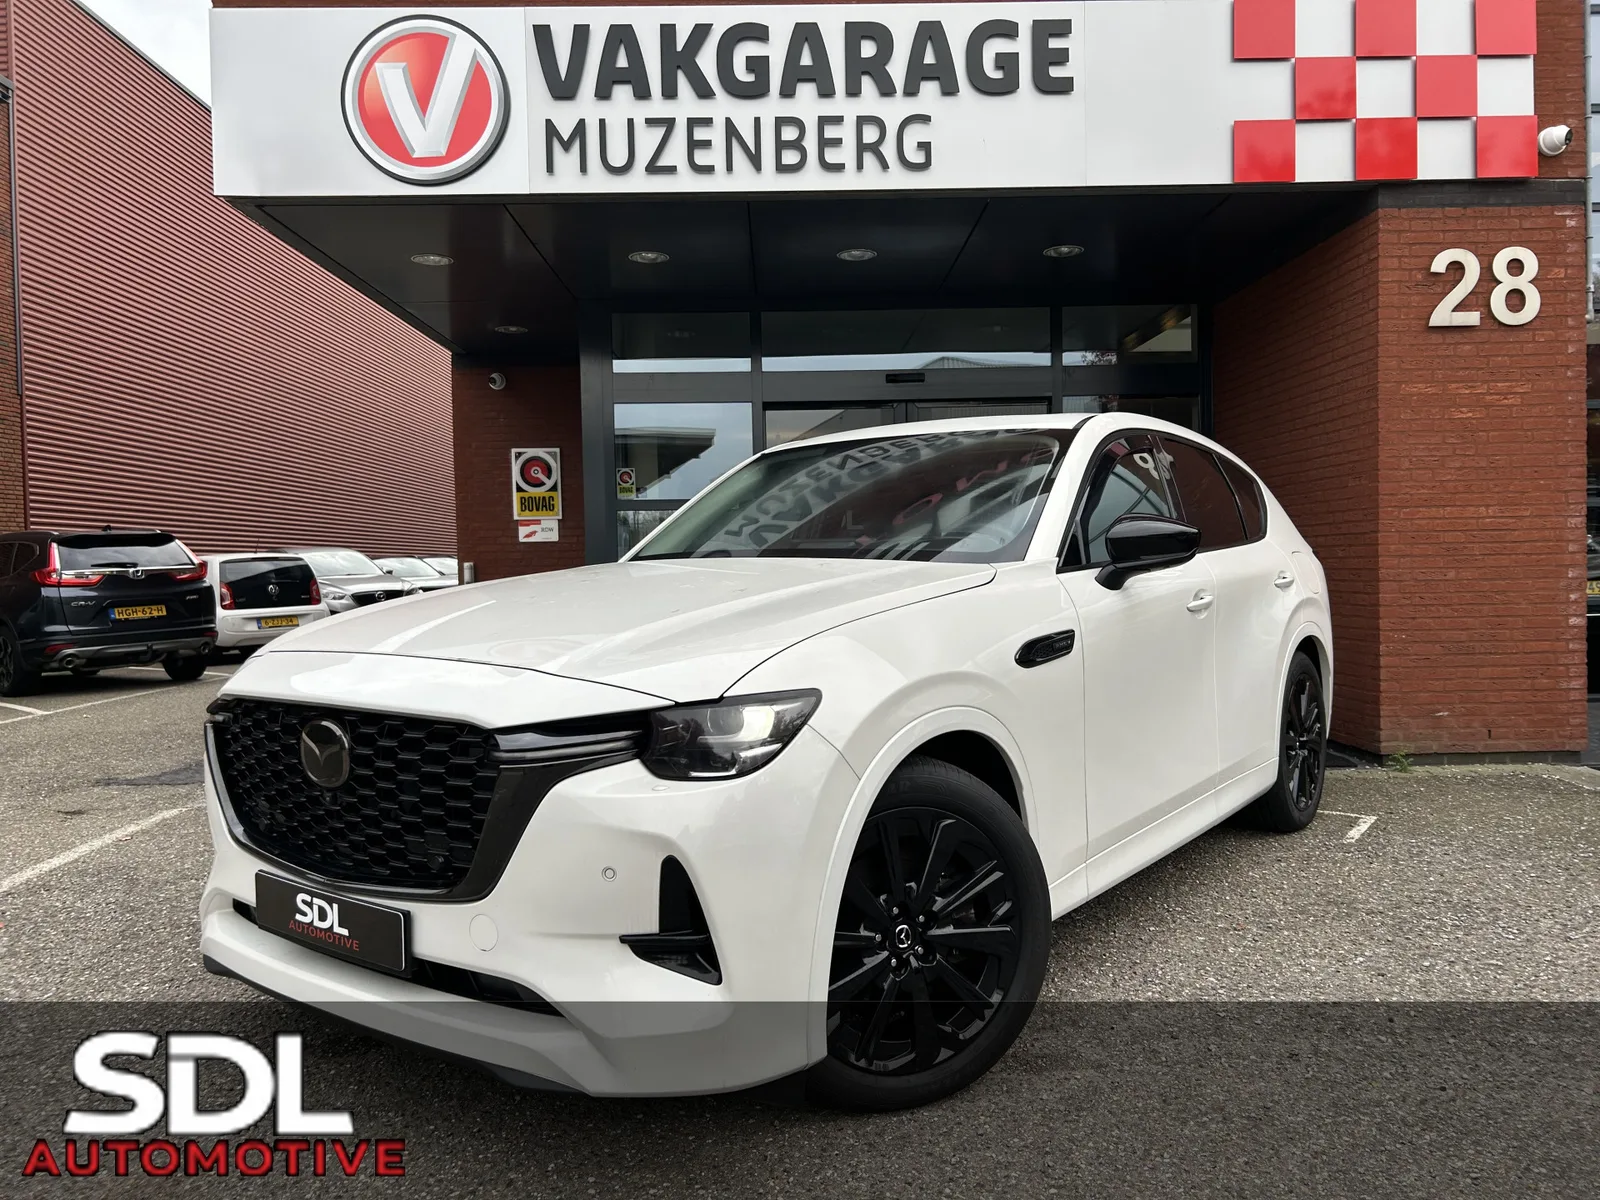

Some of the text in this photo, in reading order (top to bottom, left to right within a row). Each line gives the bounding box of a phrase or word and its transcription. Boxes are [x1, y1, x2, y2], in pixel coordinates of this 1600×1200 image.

[532, 19, 1075, 99] VAKGARAGE
[545, 114, 933, 175] MUZENBERG
[1428, 246, 1542, 327] 28
[519, 495, 555, 513] BOVAG
[618, 486, 634, 494] BOVAG
[70, 599, 97, 608] CR-V
[117, 606, 165, 618] HGH-62-H
[294, 892, 350, 937] SDL
[288, 920, 361, 952] AUTOMOTIVE
